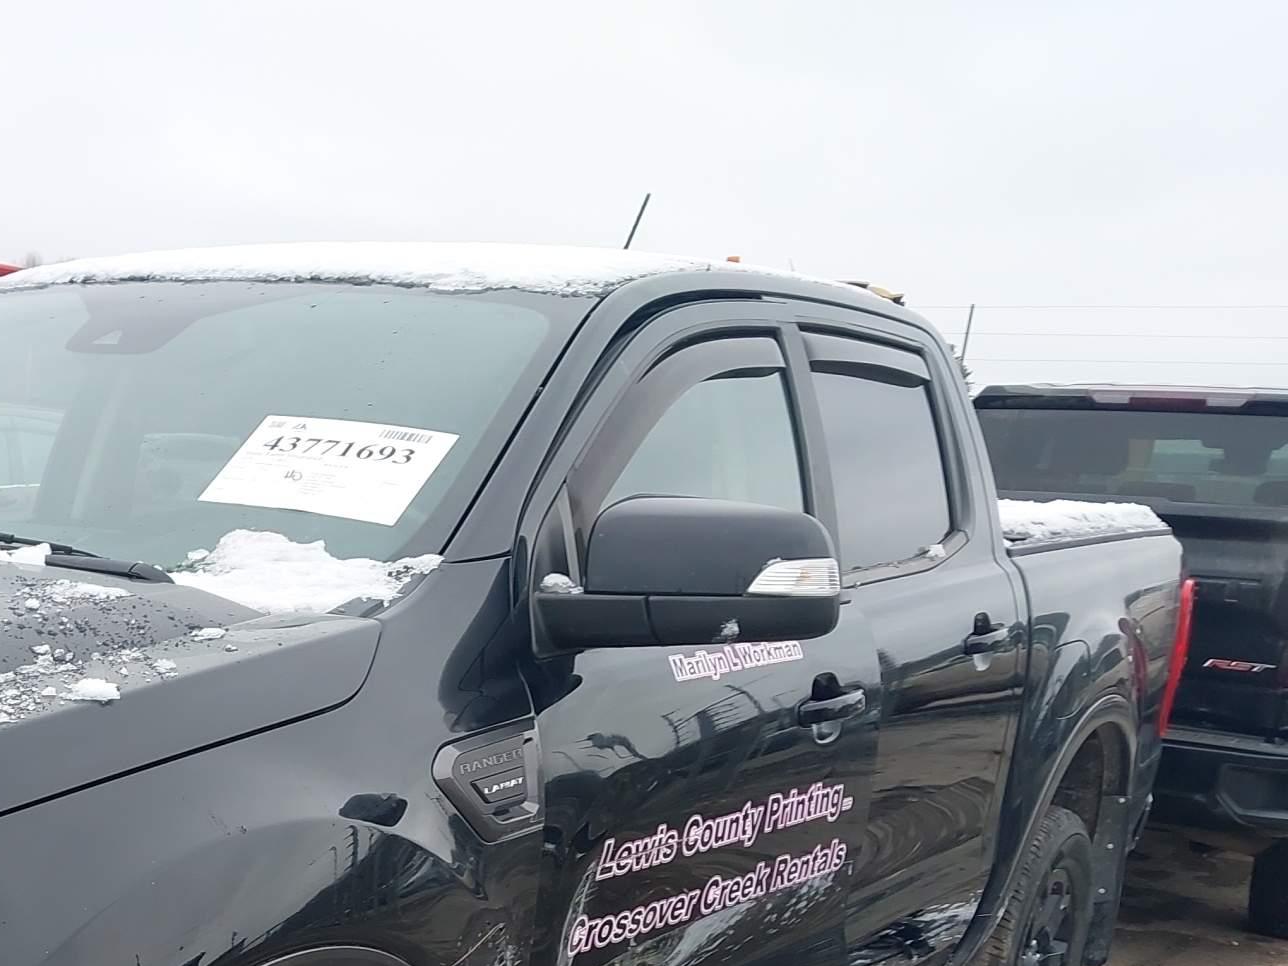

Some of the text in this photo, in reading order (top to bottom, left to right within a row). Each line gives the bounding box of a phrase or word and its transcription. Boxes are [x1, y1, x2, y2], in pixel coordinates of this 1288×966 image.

[263, 435, 416, 465] 43771693
[669, 641, 803, 680] Marilyn L Workman
[1202, 658, 1277, 673] RST
[459, 748, 523, 775] RANGER
[596, 824, 679, 880] Lewis
[682, 801, 765, 856] County
[567, 838, 847, 957] Crossover Creek Rentals
